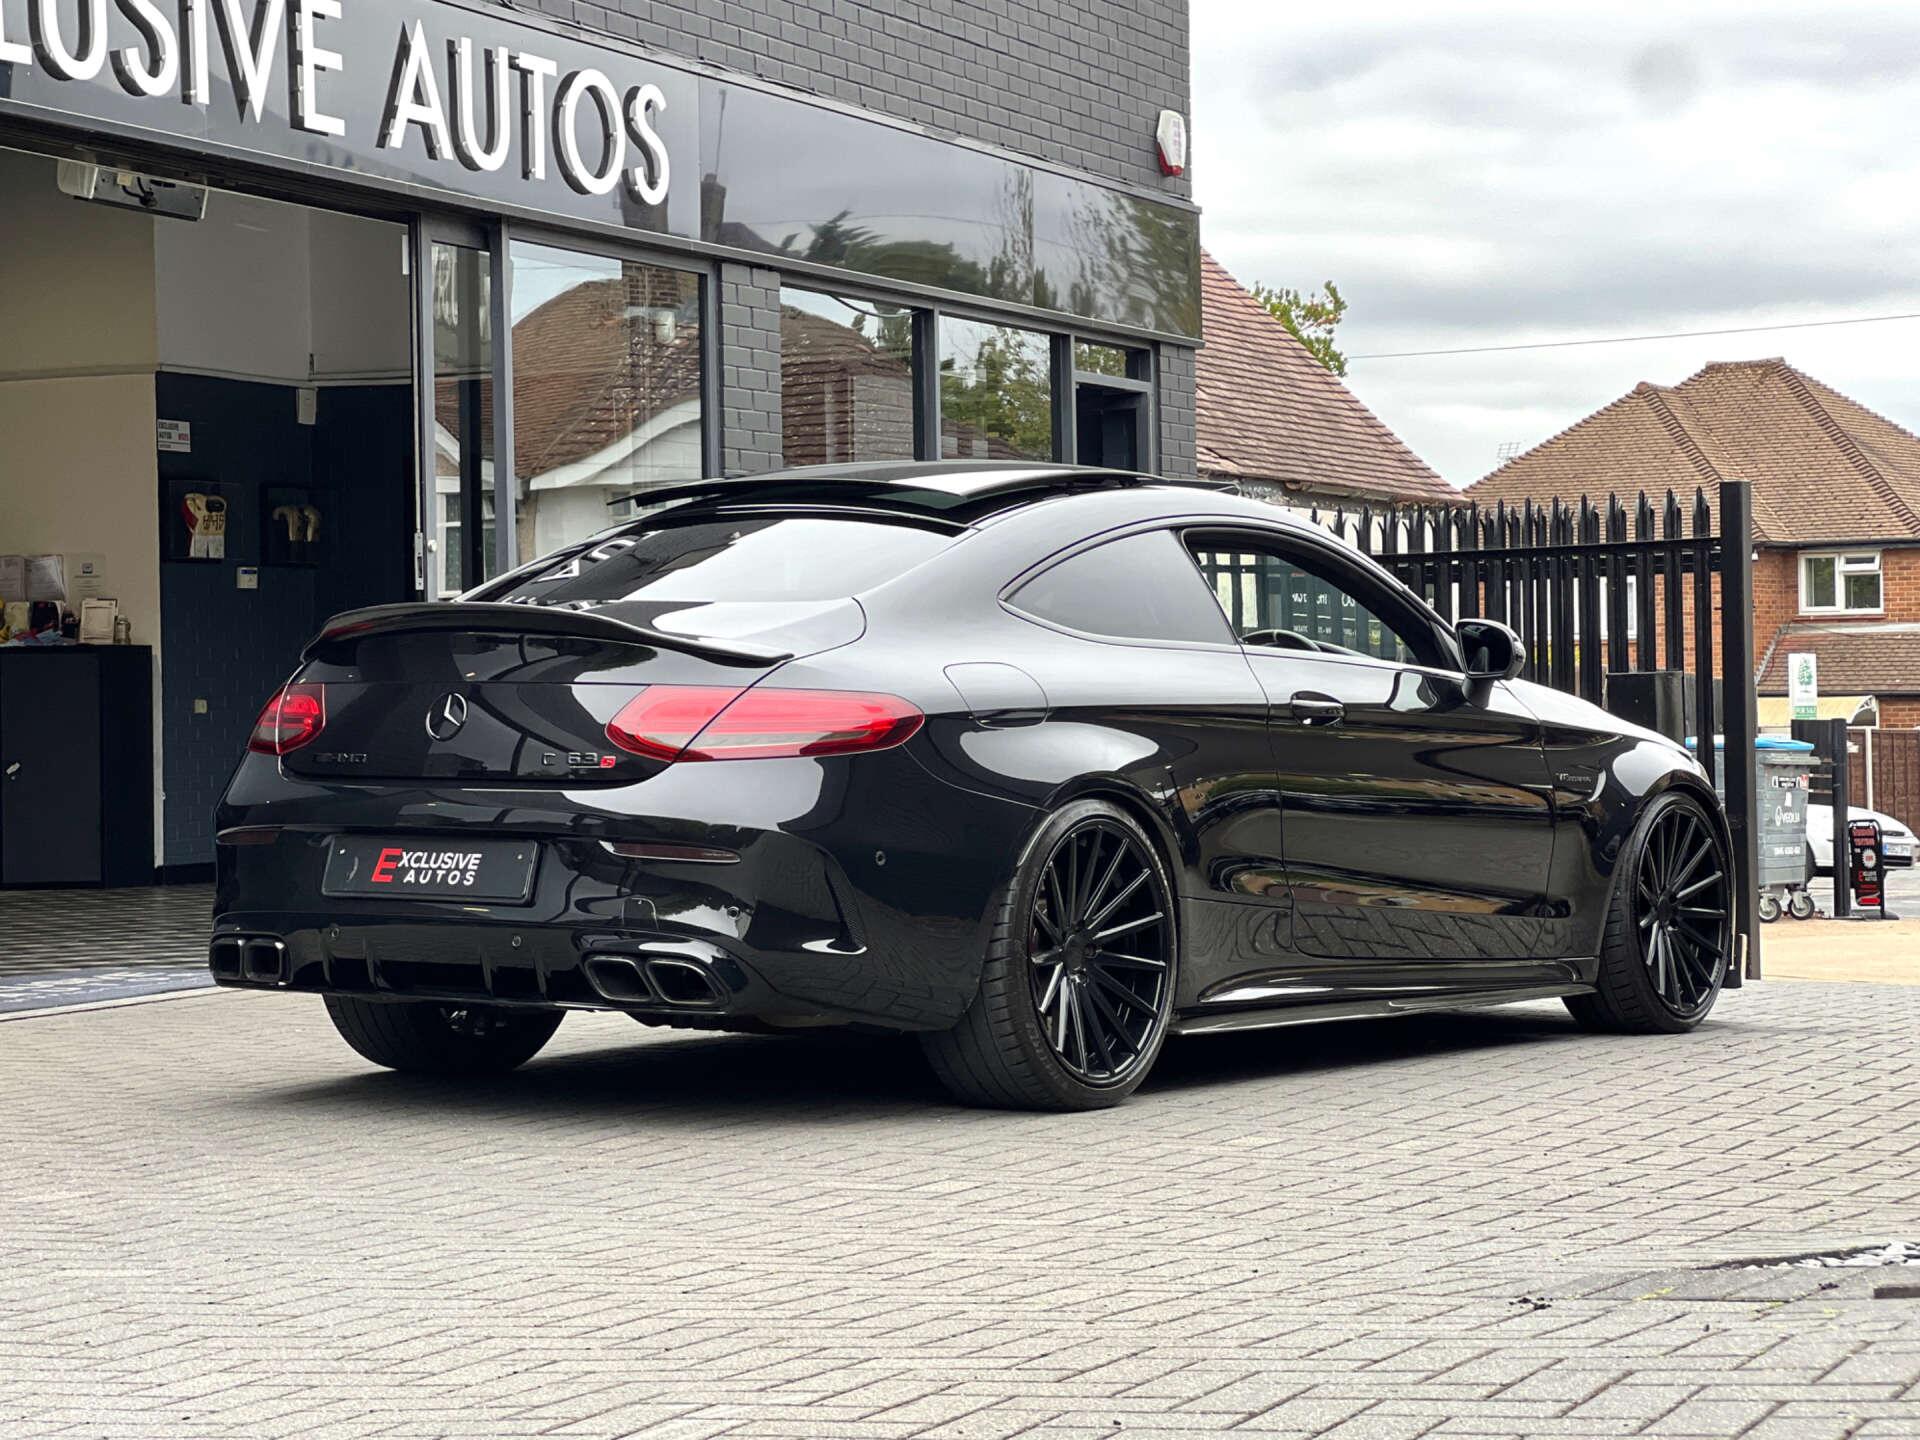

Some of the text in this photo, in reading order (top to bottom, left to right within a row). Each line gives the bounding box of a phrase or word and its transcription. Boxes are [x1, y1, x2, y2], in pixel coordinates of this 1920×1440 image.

[388, 19, 669, 206] AUTOS
[371, 848, 482, 882] EXCLUSIVE
[403, 869, 476, 885] AUTOS
